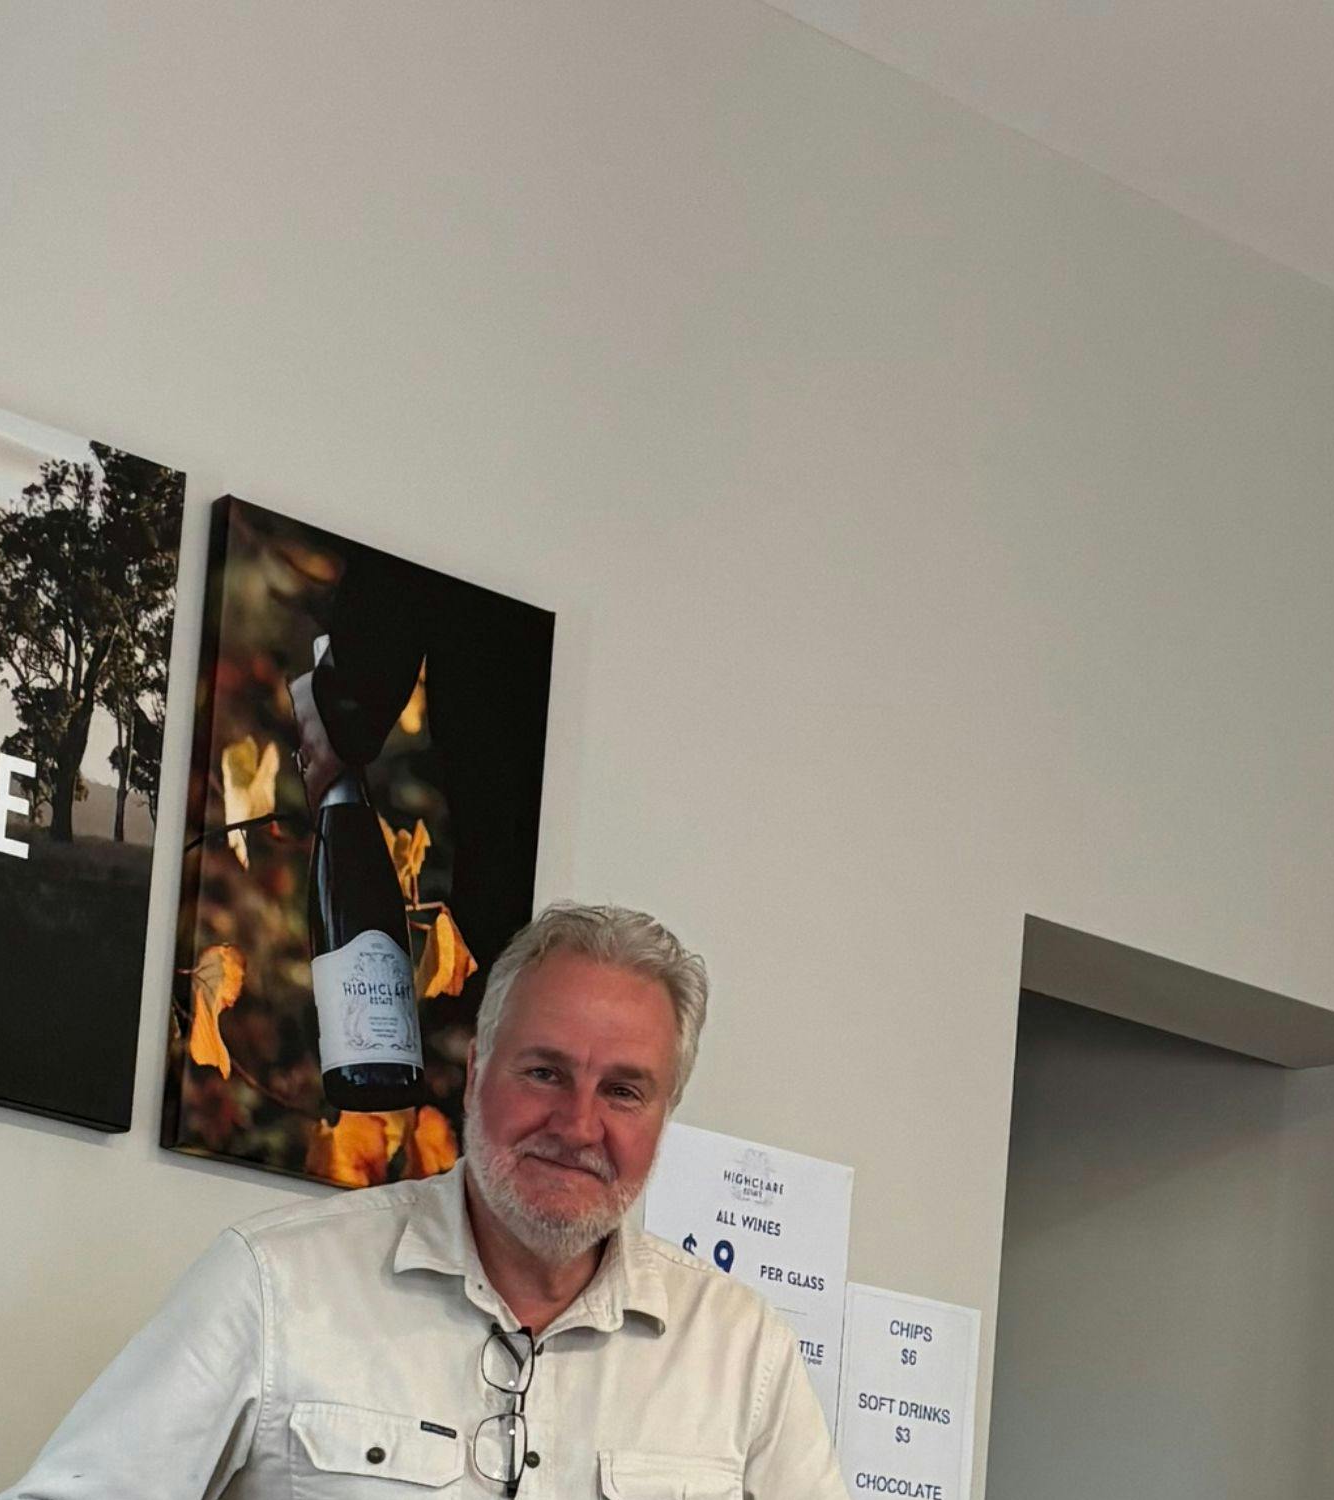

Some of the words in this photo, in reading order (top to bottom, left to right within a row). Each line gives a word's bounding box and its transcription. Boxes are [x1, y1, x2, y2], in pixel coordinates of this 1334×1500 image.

[723, 1169, 785, 1195] HIGHCLARE
[716, 1208, 737, 1227] ALL
[741, 1214, 782, 1237] WINES
[760, 1264, 783, 1283] PER
[787, 1271, 825, 1292] GLASS
[889, 1320, 933, 1342] CHIPS
[799, 1340, 824, 1358] TTLE
[900, 1348, 918, 1367] $6
[858, 1393, 895, 1416] SOFT
[898, 1400, 951, 1426] DRINKS
[895, 1425, 912, 1444] $3
